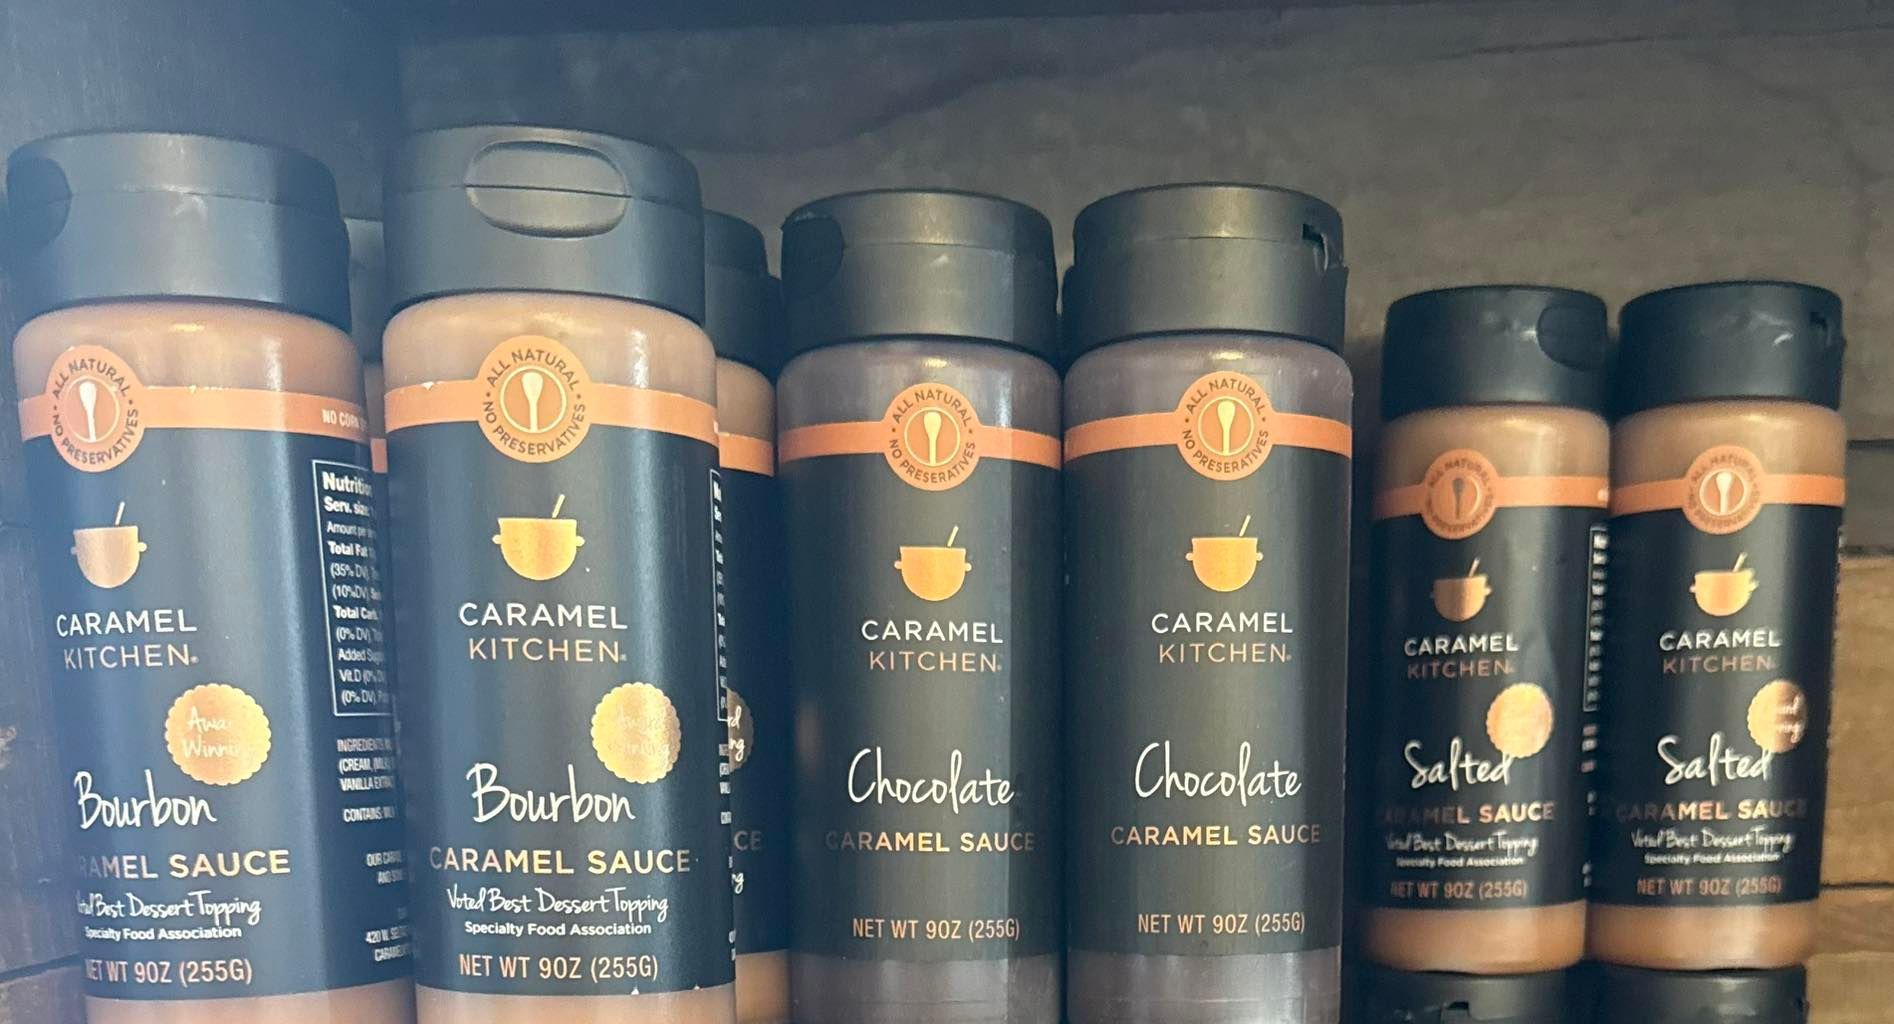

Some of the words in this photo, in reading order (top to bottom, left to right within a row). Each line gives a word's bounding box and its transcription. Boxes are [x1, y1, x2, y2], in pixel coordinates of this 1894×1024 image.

[52, 372, 70, 399] ALL
[69, 357, 132, 397] NATURAL
[486, 360, 511, 388] ALL
[510, 347, 581, 391] NATURAL
[892, 399, 913, 425] ALL
[913, 388, 972, 428] NATURAL
[1187, 389, 1208, 415] ALL
[1208, 377, 1266, 414] NATURAL
[52, 413, 63, 437] NO
[62, 408, 139, 465] PRESERVATIVES
[482, 400, 497, 425] NO
[493, 403, 587, 456] PRESERVATIVES
[888, 438, 901, 460] NO
[899, 441, 976, 484] PRESERATIVES
[1182, 429, 1196, 451] NO
[1192, 429, 1269, 474] PRESERATIVES
[57, 607, 198, 637] CARAMEL
[459, 601, 628, 630] CARAMEL
[1151, 612, 1294, 634] CARAMEL
[861, 620, 1004, 644] CARAMEL
[1404, 631, 1519, 656] CARAMEL
[1659, 629, 1782, 652] CARAMEL
[63, 643, 192, 670] KITCHEN
[468, 637, 622, 663] KITCHEN
[869, 651, 998, 673] KITCHEN
[1159, 643, 1287, 664] KITCHEN
[1407, 658, 1512, 679] KITCHEN
[1662, 655, 1773, 675] KITCHEN
[1135, 739, 1302, 807] Chocolate
[1404, 736, 1515, 792] Salted
[1657, 731, 1776, 787] Salted
[466, 762, 636, 823] Bourbon
[847, 746, 1015, 815] Chocolate
[74, 769, 217, 830] Bourbon
[1479, 802, 1555, 824] SAUCE
[825, 831, 950, 853] CARAMEL
[960, 831, 1036, 853] SAUCE
[1111, 825, 1238, 846] CARAMEL
[1247, 824, 1321, 845] SAUCE
[169, 849, 291, 879] SAUCE
[429, 846, 575, 875] CARAMEL
[587, 848, 691, 875] SAUCE
[1478, 880, 1528, 899] (255G)
[1670, 878, 1695, 895] WT
[127, 892, 193, 918] Dessert
[188, 890, 262, 926] Topping
[447, 883, 486, 912] Voted
[487, 887, 532, 913] Best
[536, 887, 608, 914] Dessert
[605, 886, 669, 922] Topping
[123, 926, 154, 941] Food
[157, 926, 242, 940] Association
[464, 922, 523, 937] Specialty
[527, 923, 566, 936] Food
[570, 922, 652, 936] Association
[853, 918, 885, 939] NET
[890, 919, 918, 940] WT
[925, 920, 962, 940] 9OZ
[968, 918, 1021, 944] (255G)
[1137, 913, 1171, 934] NET
[1177, 914, 1206, 934] WT
[1212, 914, 1249, 934] 9OZ
[1254, 911, 1305, 937] (255G)
[106, 961, 128, 982] WT
[135, 960, 172, 984] 9OZ
[179, 958, 253, 989] (255G)
[459, 954, 493, 977] NET
[499, 955, 530, 979] WT
[539, 956, 582, 980] 9OZ
[590, 954, 659, 983] (255G)
